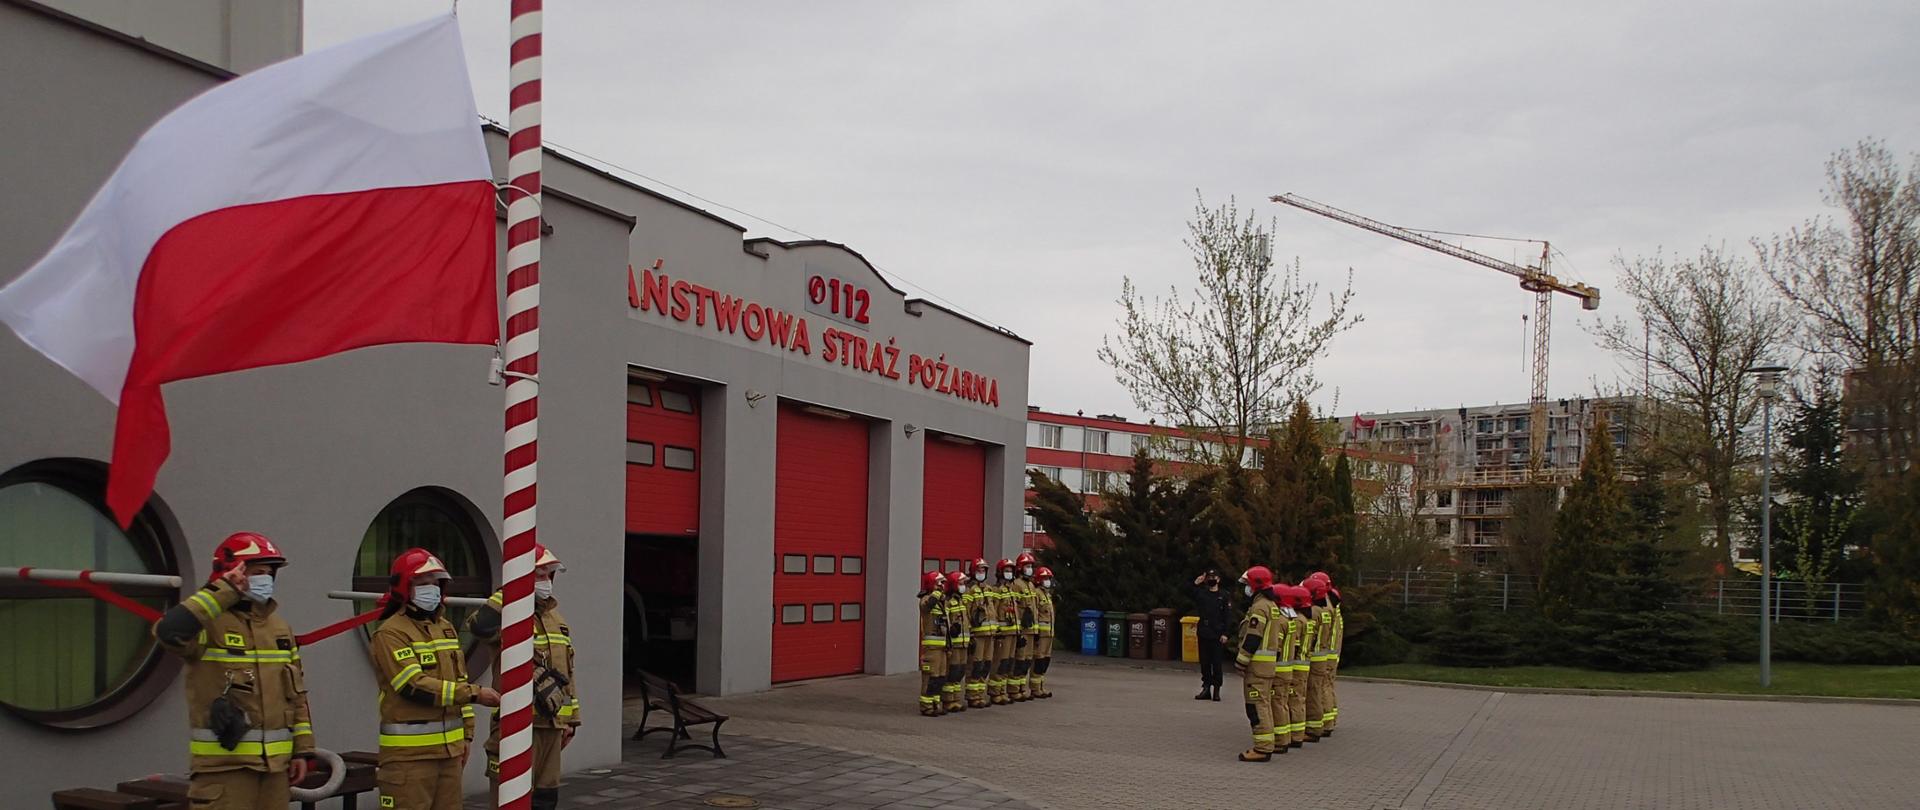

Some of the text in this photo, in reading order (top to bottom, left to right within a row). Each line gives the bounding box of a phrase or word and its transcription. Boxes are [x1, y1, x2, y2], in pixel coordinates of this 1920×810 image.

[823, 327, 901, 380] STRAŻ
[909, 353, 999, 408] POŻARNA
[397, 649, 412, 658] PSP
